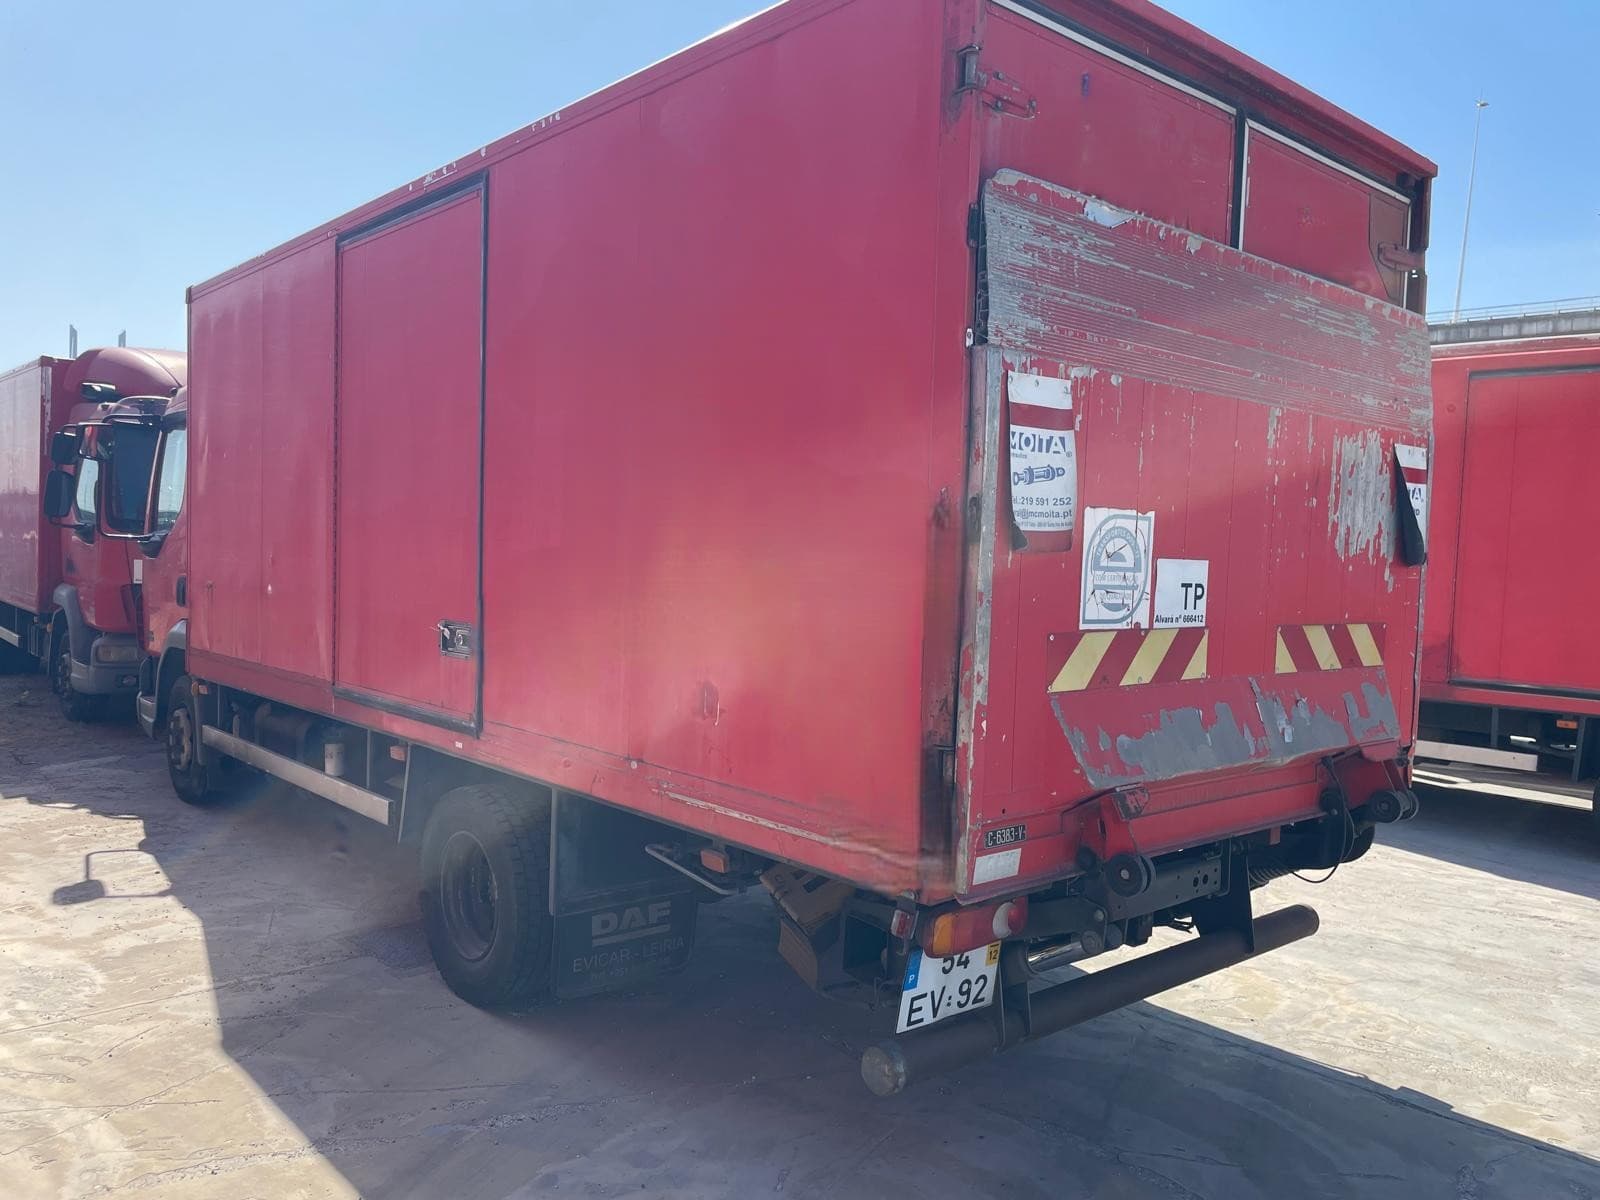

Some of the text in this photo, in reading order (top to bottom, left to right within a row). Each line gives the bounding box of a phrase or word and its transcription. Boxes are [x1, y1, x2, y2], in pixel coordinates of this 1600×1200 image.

[1035, 497, 1049, 506] 591
[1052, 496, 1072, 506] 252
[1181, 583, 1205, 610] TP
[592, 901, 671, 936] DAF
